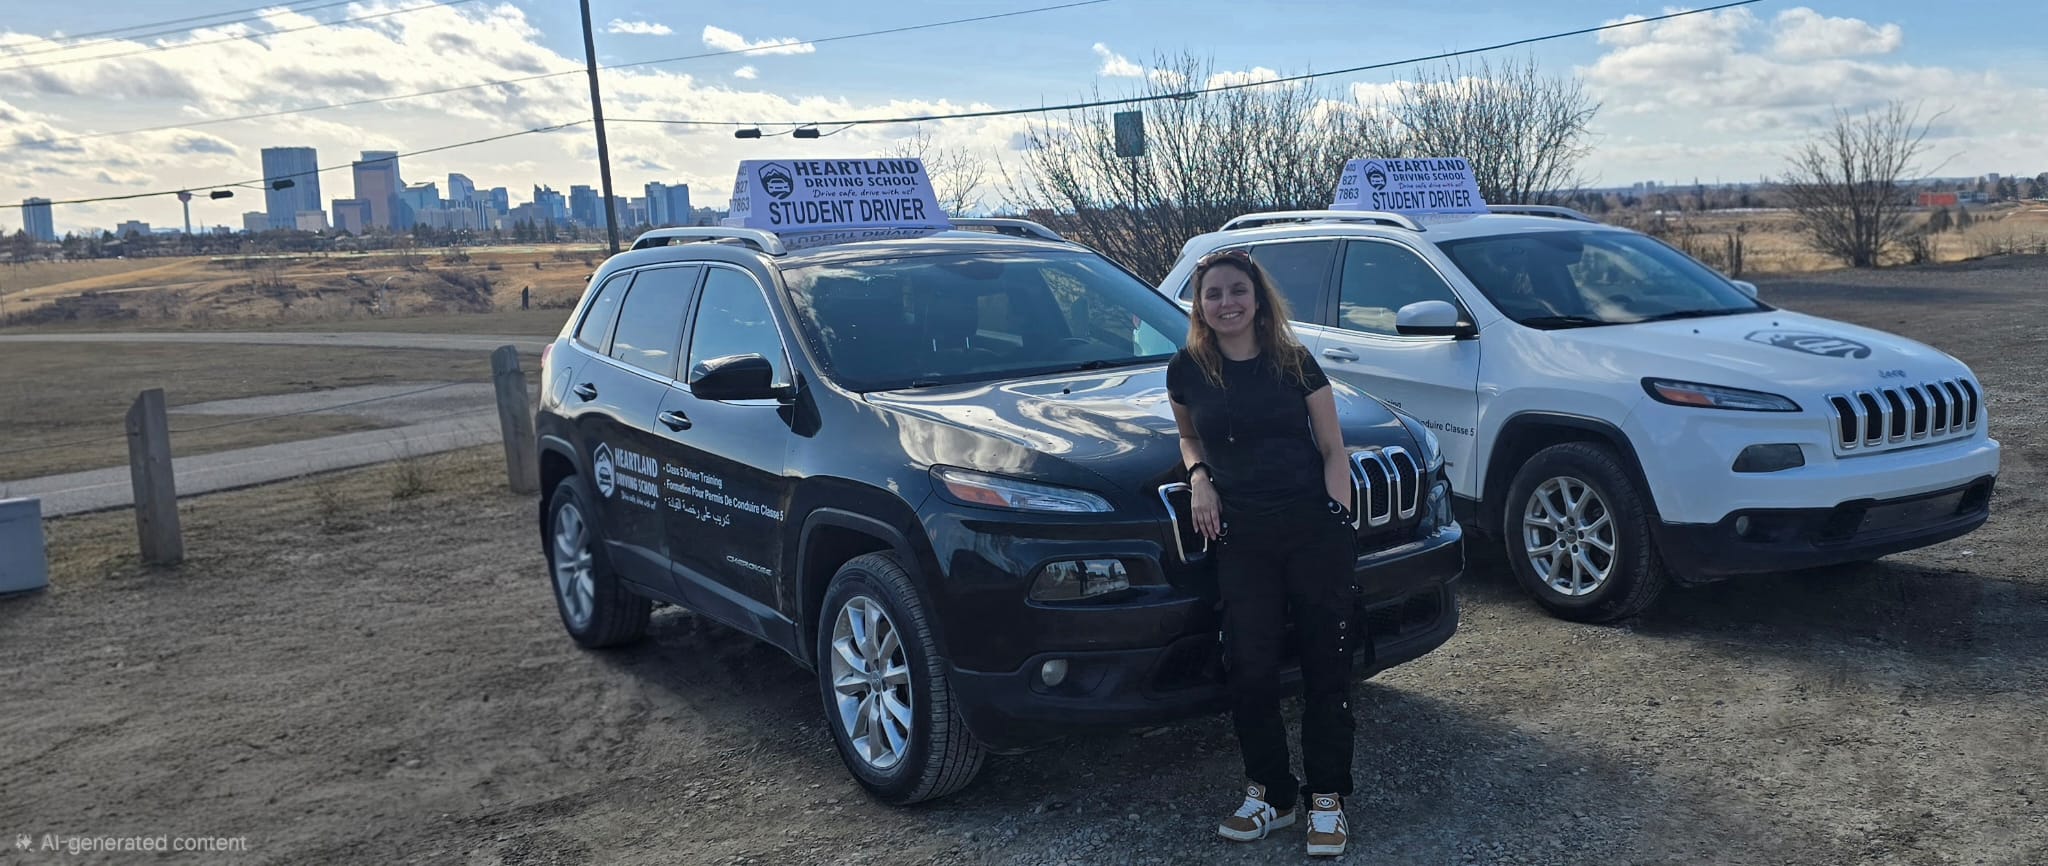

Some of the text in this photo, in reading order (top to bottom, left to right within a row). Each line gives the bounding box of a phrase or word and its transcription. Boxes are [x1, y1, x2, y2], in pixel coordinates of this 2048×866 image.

[794, 160, 919, 176] HEARTLAND
[1386, 160, 1465, 173] HEARTLAND
[805, 175, 919, 188] DRIVING SCHOOL
[1394, 172, 1466, 182] DRIVING SCHOOL
[1339, 187, 1359, 200] 7863
[1373, 190, 1472, 210] STUDENT DRIVER
[770, 198, 926, 225] STUDENT DRIVER
[1446, 421, 1469, 436] Classe
[1470, 427, 1475, 437] 5
[615, 447, 658, 478] HEARTLAND
[666, 463, 680, 477] Class
[685, 467, 700, 481] Driver
[701, 471, 723, 490] Training
[639, 479, 659, 499] SCHOOL
[667, 479, 784, 522] Formation Pour Permis De Conduire Classe 5
